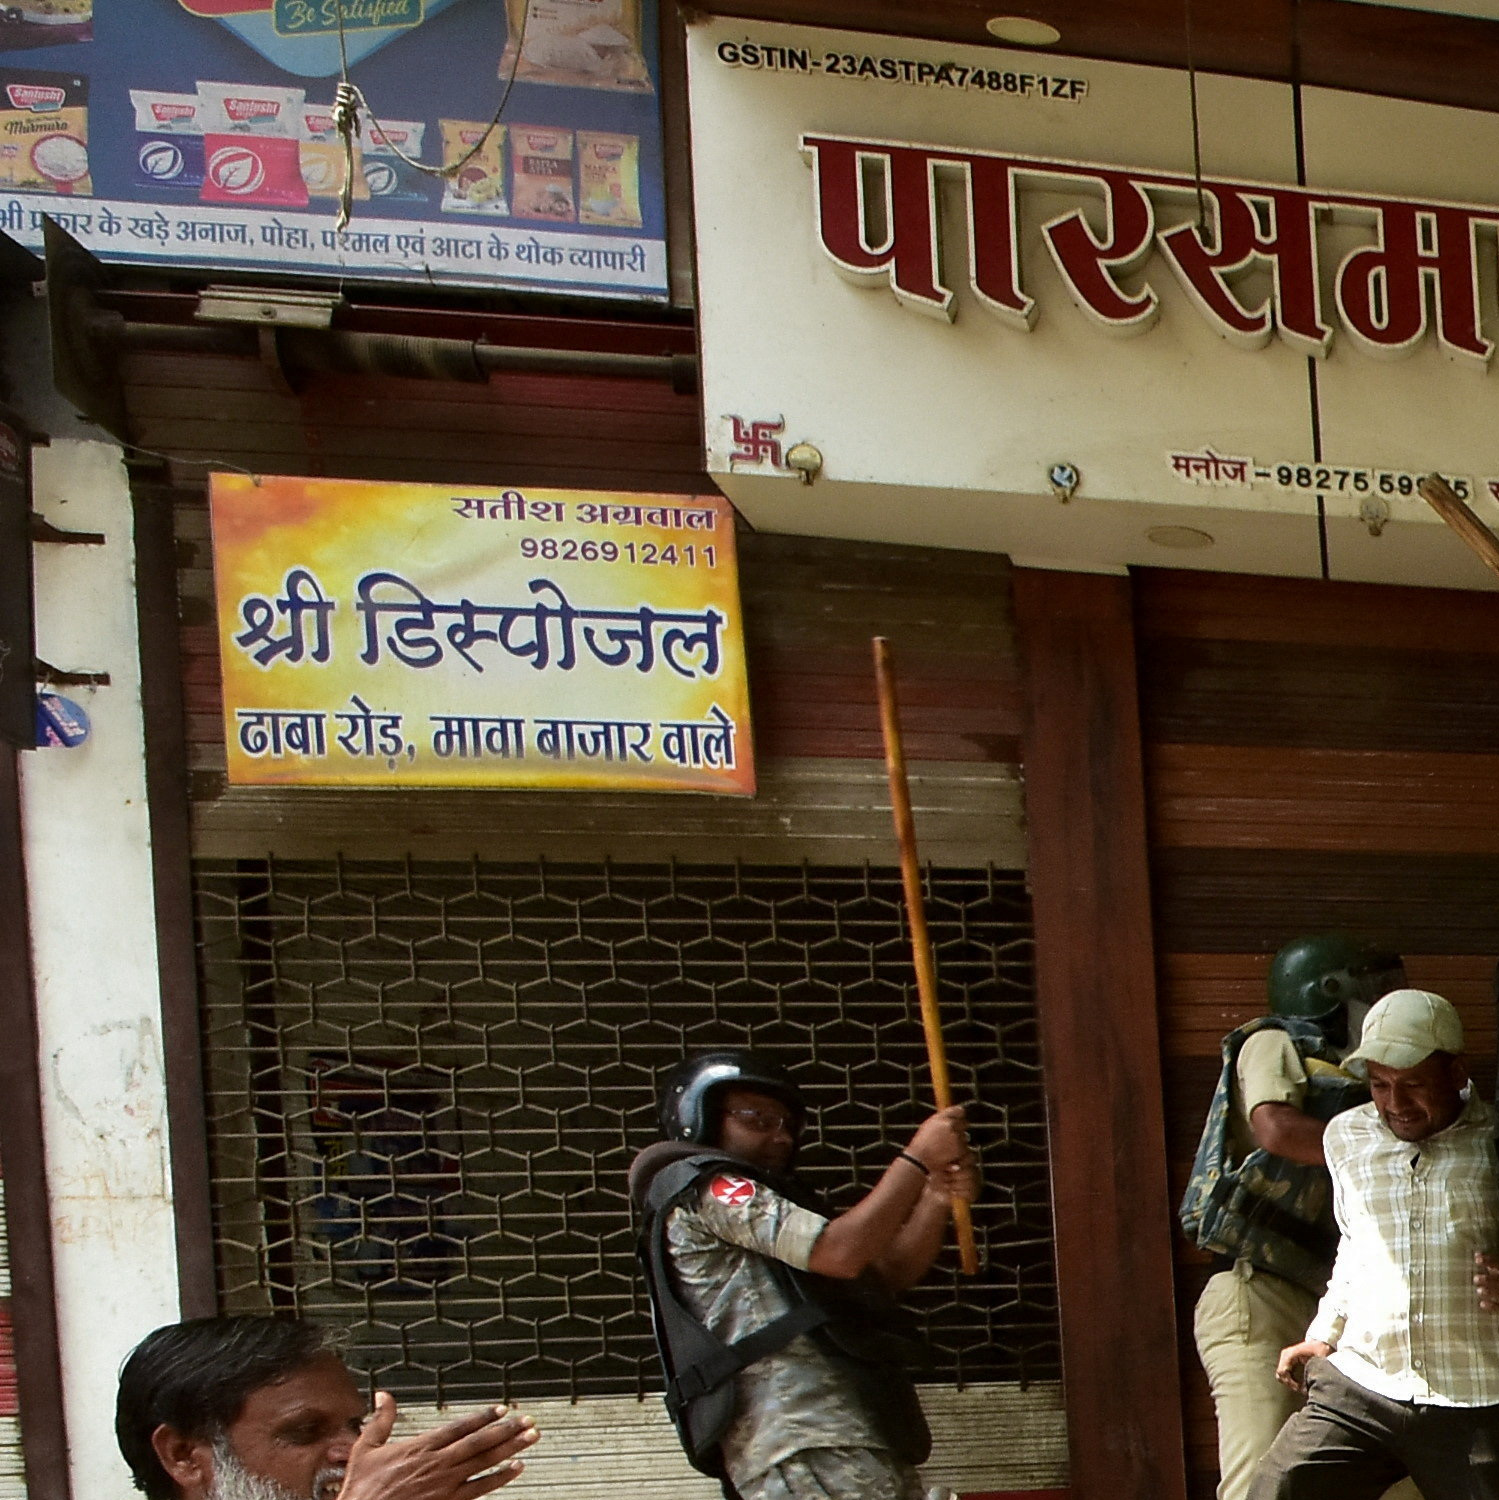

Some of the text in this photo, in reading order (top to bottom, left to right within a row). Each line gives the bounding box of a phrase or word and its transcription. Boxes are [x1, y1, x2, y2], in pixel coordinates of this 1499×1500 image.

[98, 206, 122, 237] के
[396, 228, 426, 259] एवं
[432, 236, 482, 260] आटा
[488, 233, 508, 261] के
[515, 236, 563, 266] थोक
[570, 243, 647, 273] व्यापारी
[1171, 450, 1248, 483] मनोज
[451, 491, 716, 532] सतीश अग्रवाल
[520, 537, 718, 568] 9826912411
[236, 567, 724, 678] श्री डिस्पोजल
[237, 708, 327, 757] ढाबा
[429, 716, 525, 760] मावा
[535, 719, 653, 761] बाजार
[661, 706, 736, 769] वाले
